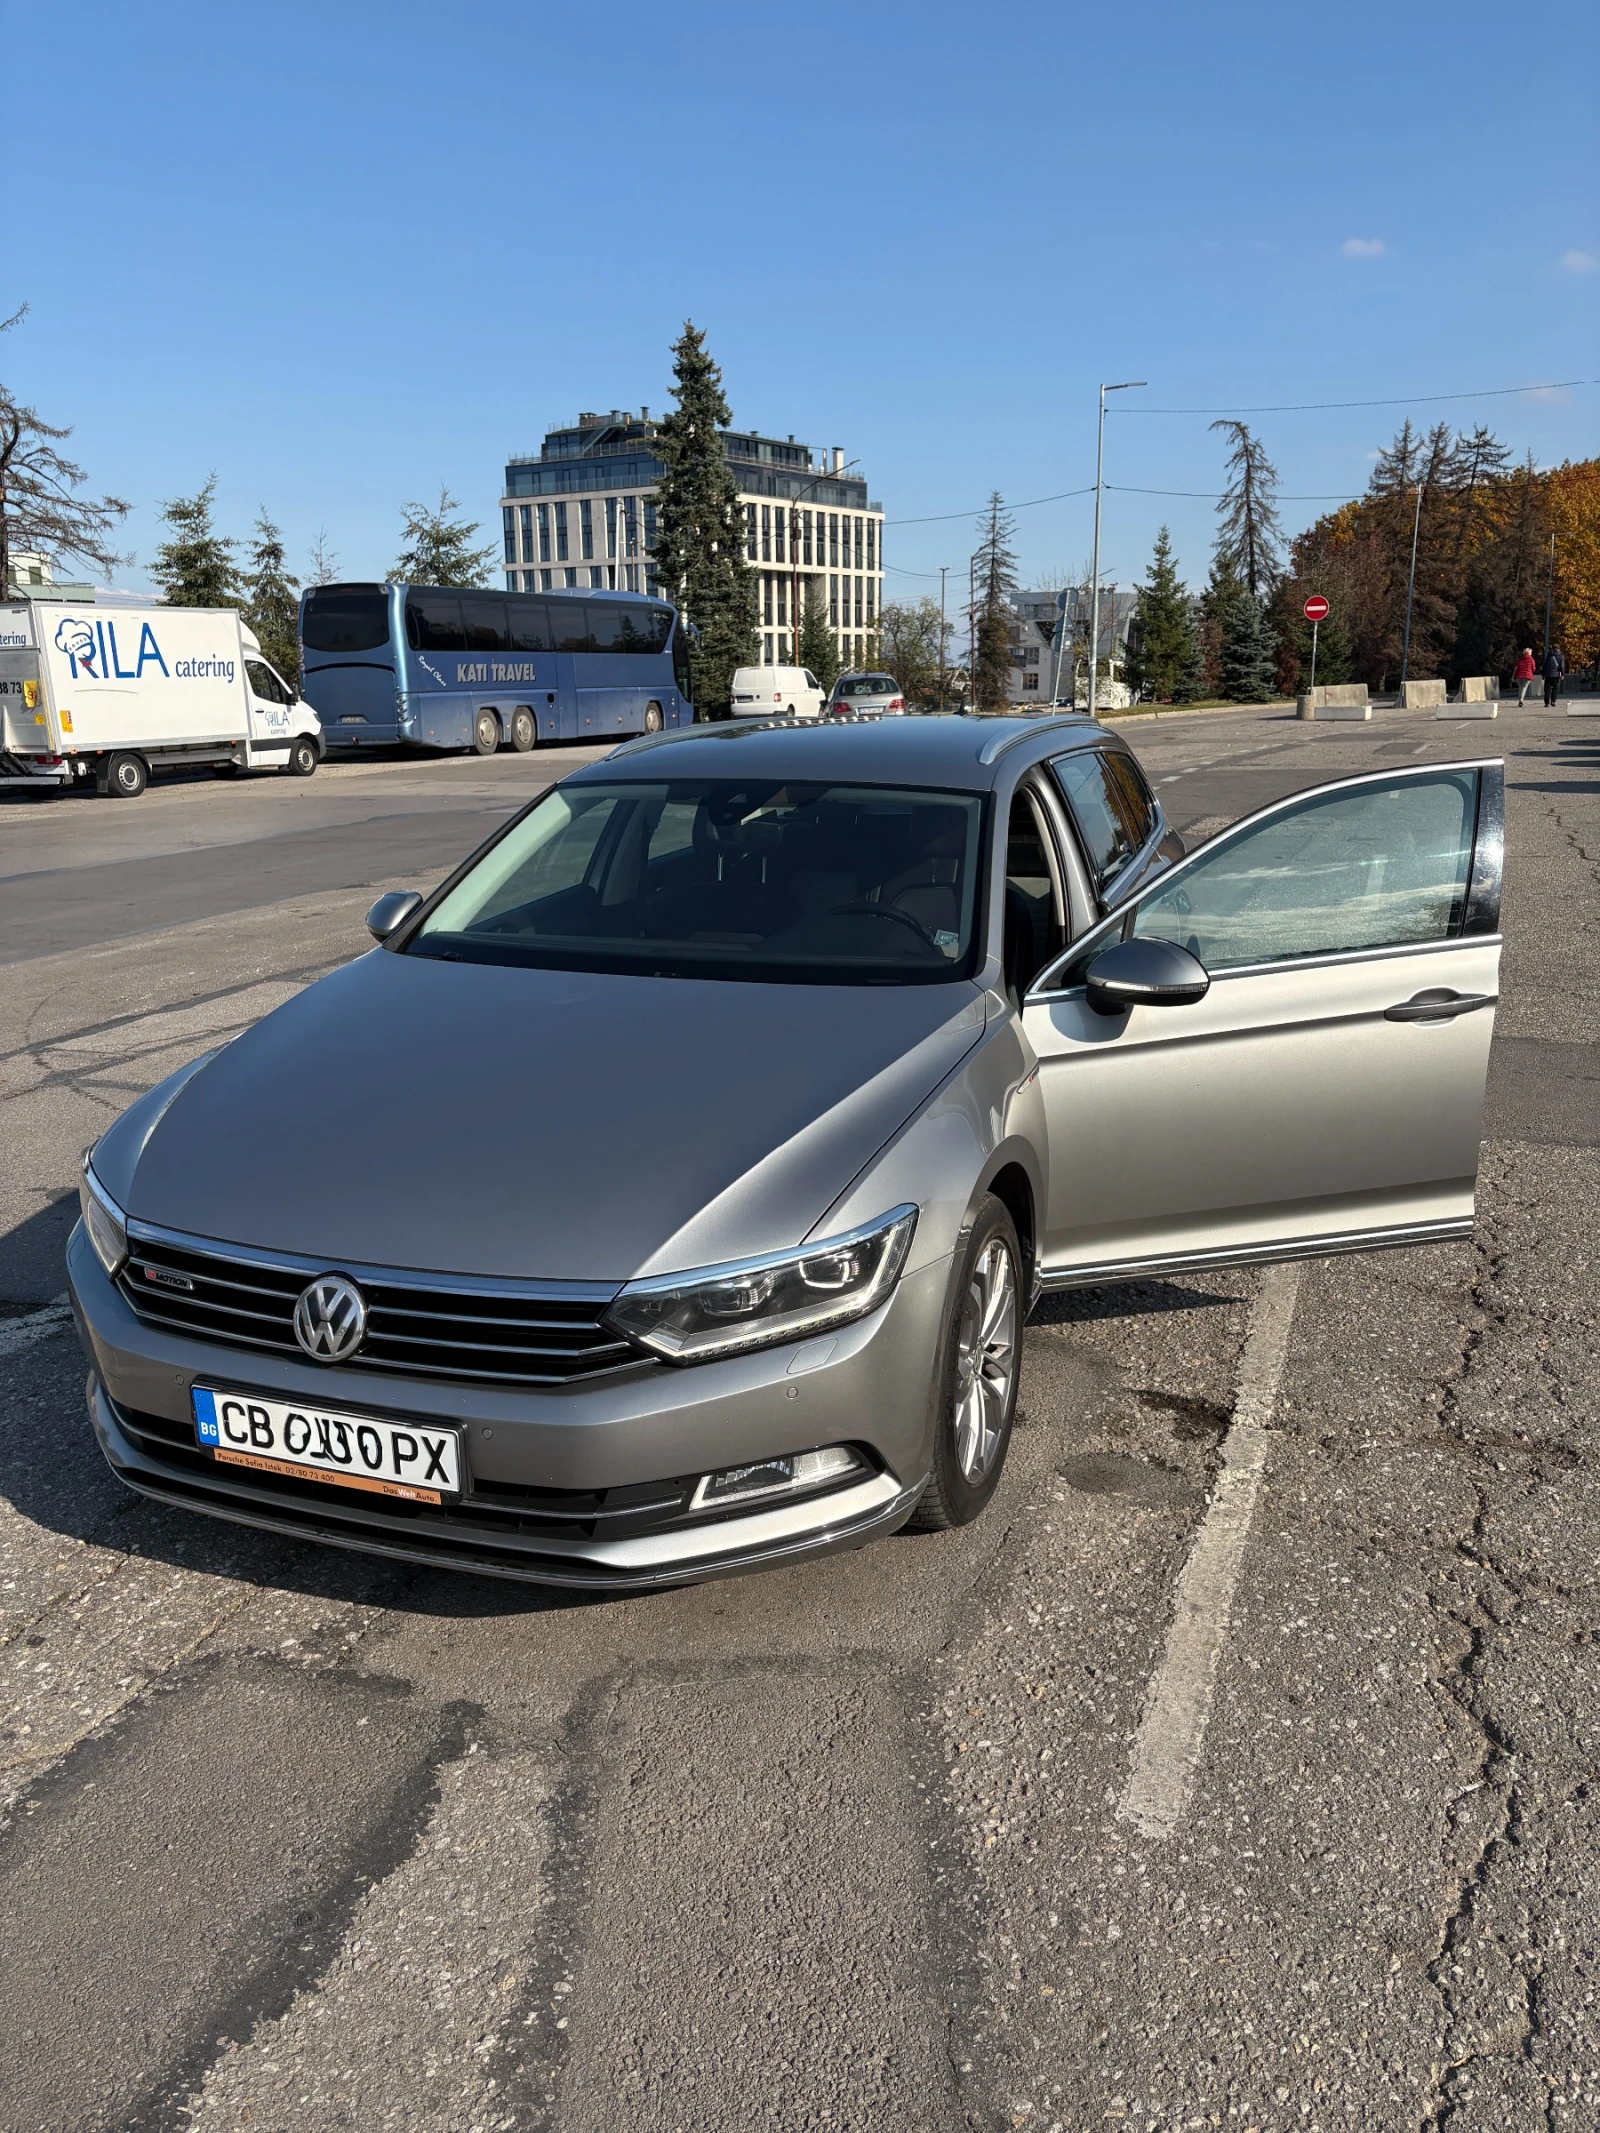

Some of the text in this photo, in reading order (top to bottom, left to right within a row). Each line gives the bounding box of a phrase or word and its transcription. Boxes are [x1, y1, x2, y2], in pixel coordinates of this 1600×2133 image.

[56, 618, 234, 684] RILA catering
[457, 664, 536, 683] KATI TRAVEL
[201, 1421, 217, 1437] BG
[222, 1401, 275, 1449] CB
[391, 1431, 451, 1484] PX
[217, 1453, 244, 1464] Porsche
[245, 1458, 264, 1468] Sofia
[309, 1472, 319, 1480] 73
[321, 1474, 335, 1483] 400
